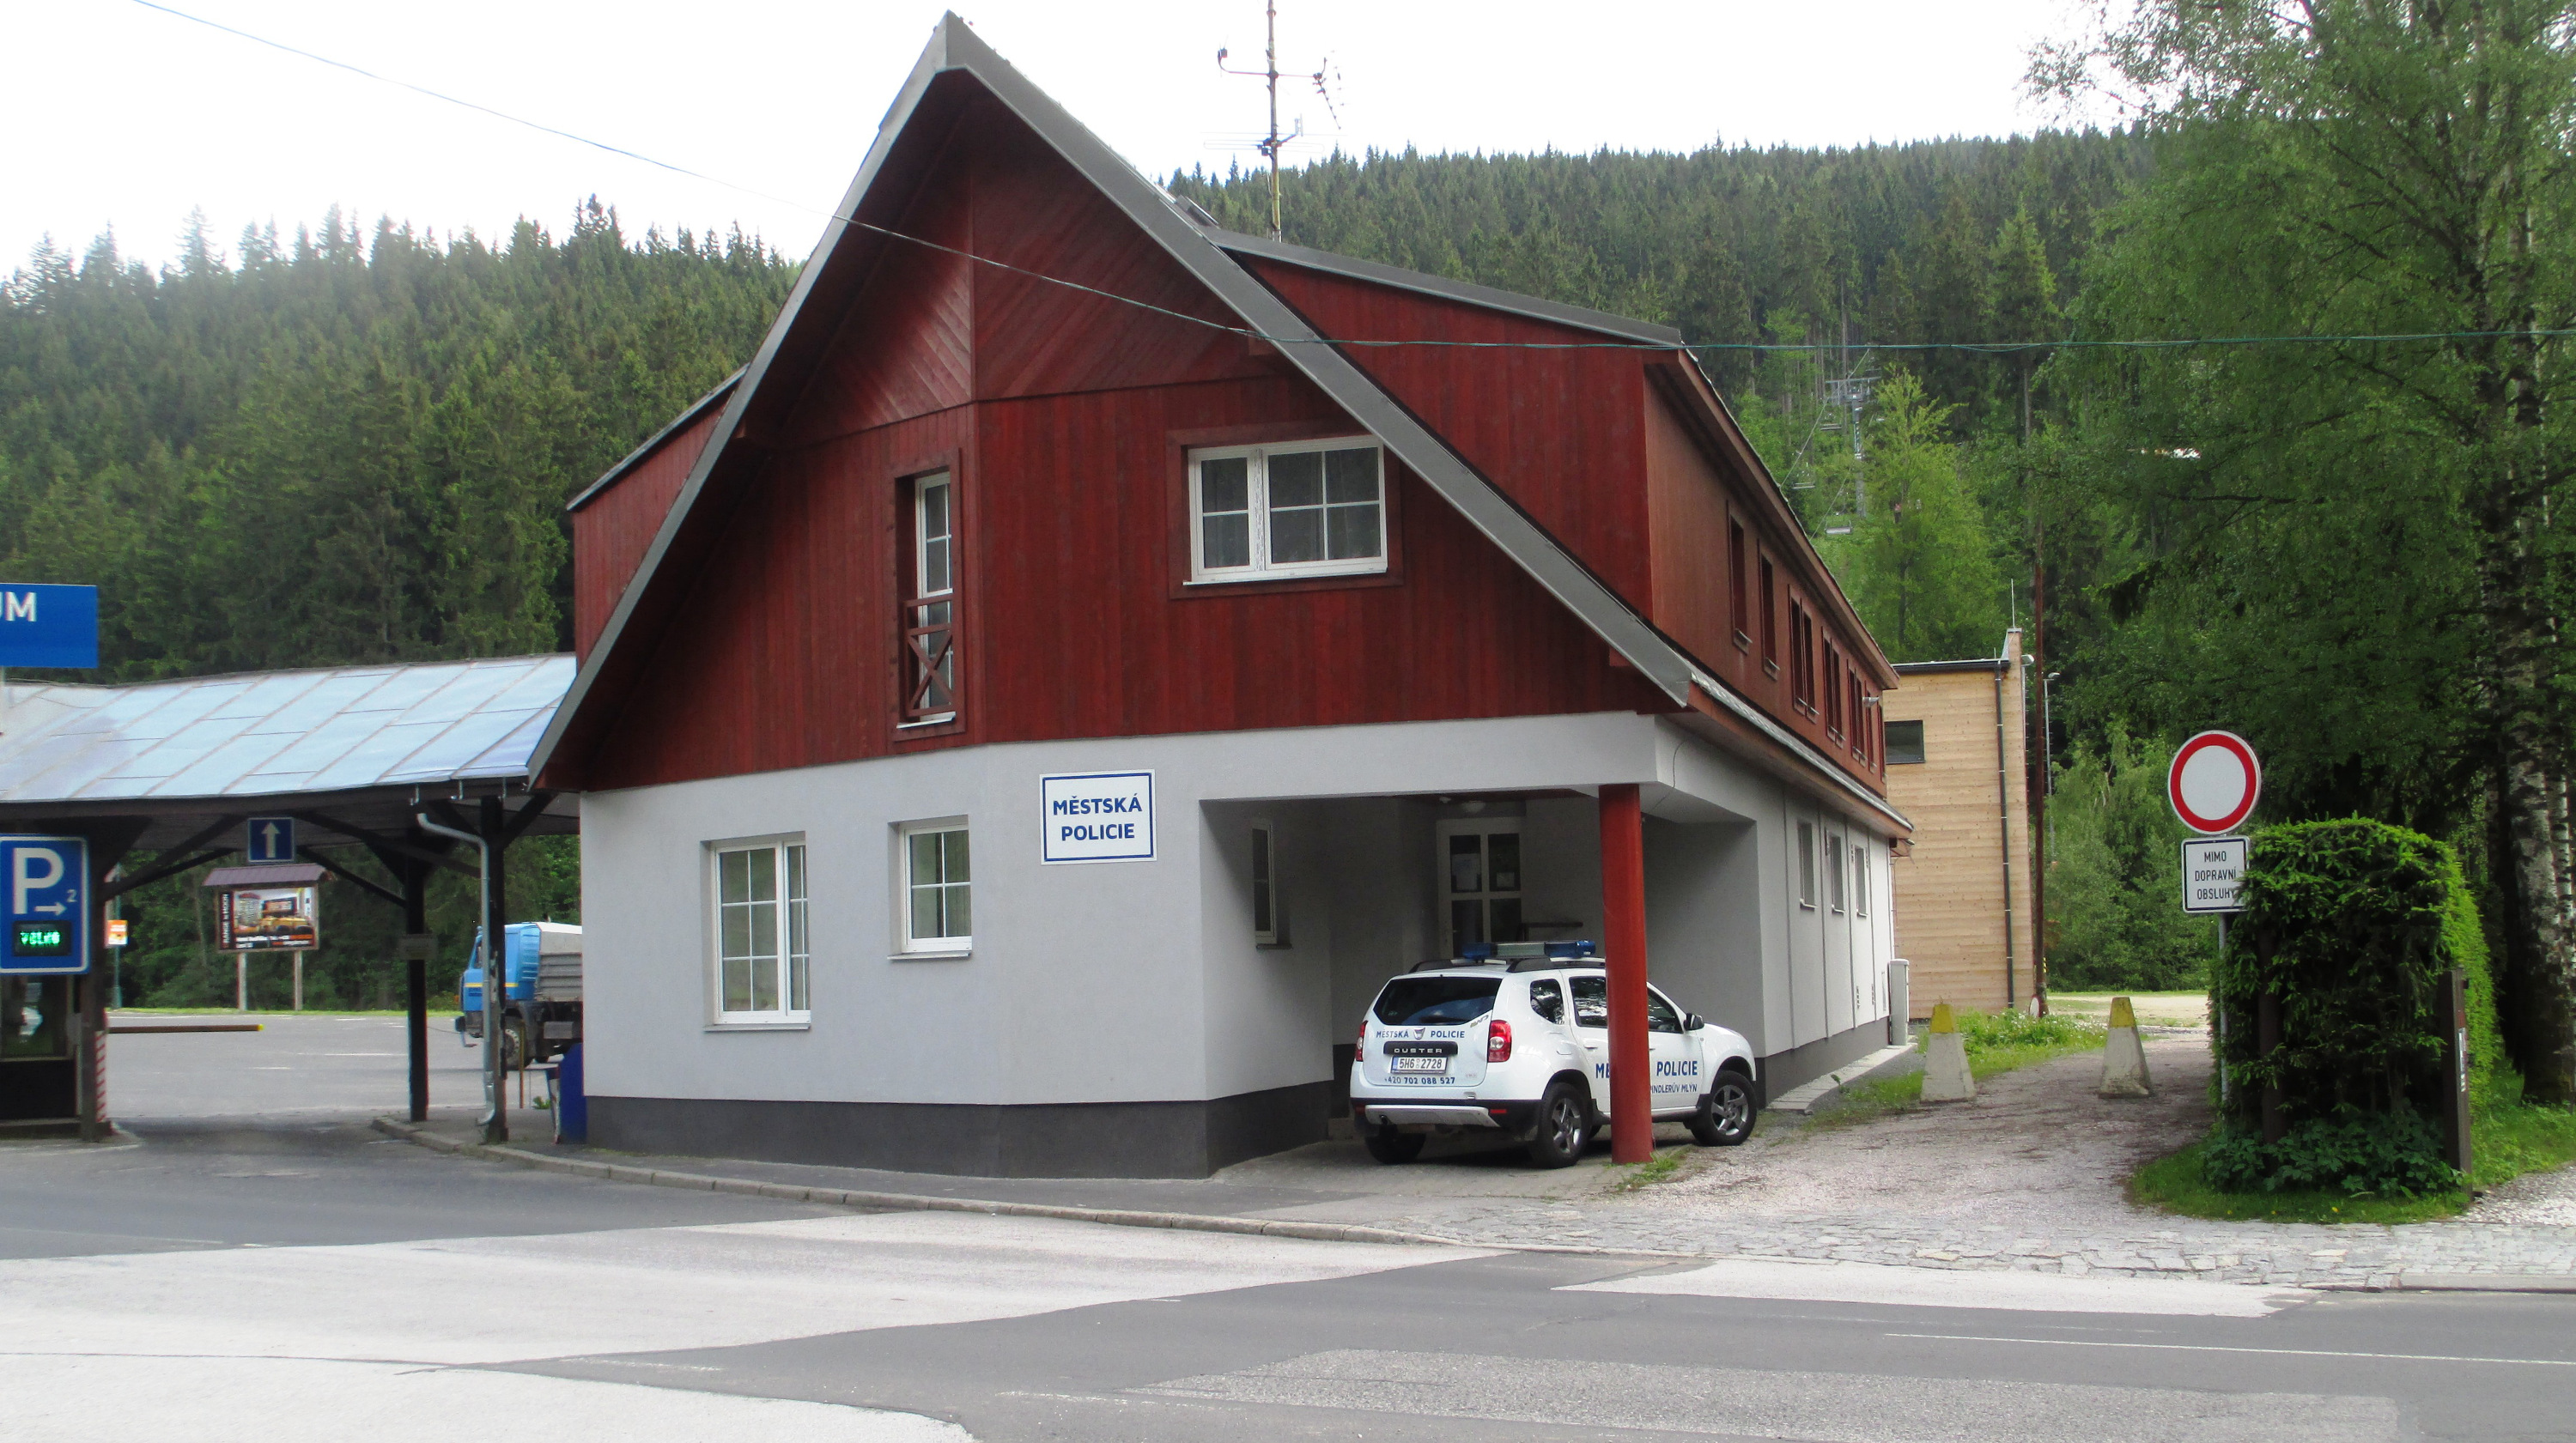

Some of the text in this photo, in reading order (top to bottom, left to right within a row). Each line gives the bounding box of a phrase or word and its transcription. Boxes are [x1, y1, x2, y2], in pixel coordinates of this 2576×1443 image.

[1053, 792, 1143, 815] MĚSTSKÁ
[1061, 822, 1135, 841] POLICIE
[2203, 851, 2227, 863] MIMO
[13, 847, 64, 915] P
[2195, 865, 2237, 882] DOPRAVNÍ
[66, 888, 78, 902] 2
[1376, 1028, 1466, 1039] MĚSTSKÁ POLICIE
[1399, 1058, 1443, 1069] 5H6 2728
[1656, 1060, 1698, 1076] POLICIE
[1404, 1076, 1419, 1085] 702
[1421, 1076, 1437, 1085] 088
[1440, 1076, 1455, 1085] 527
